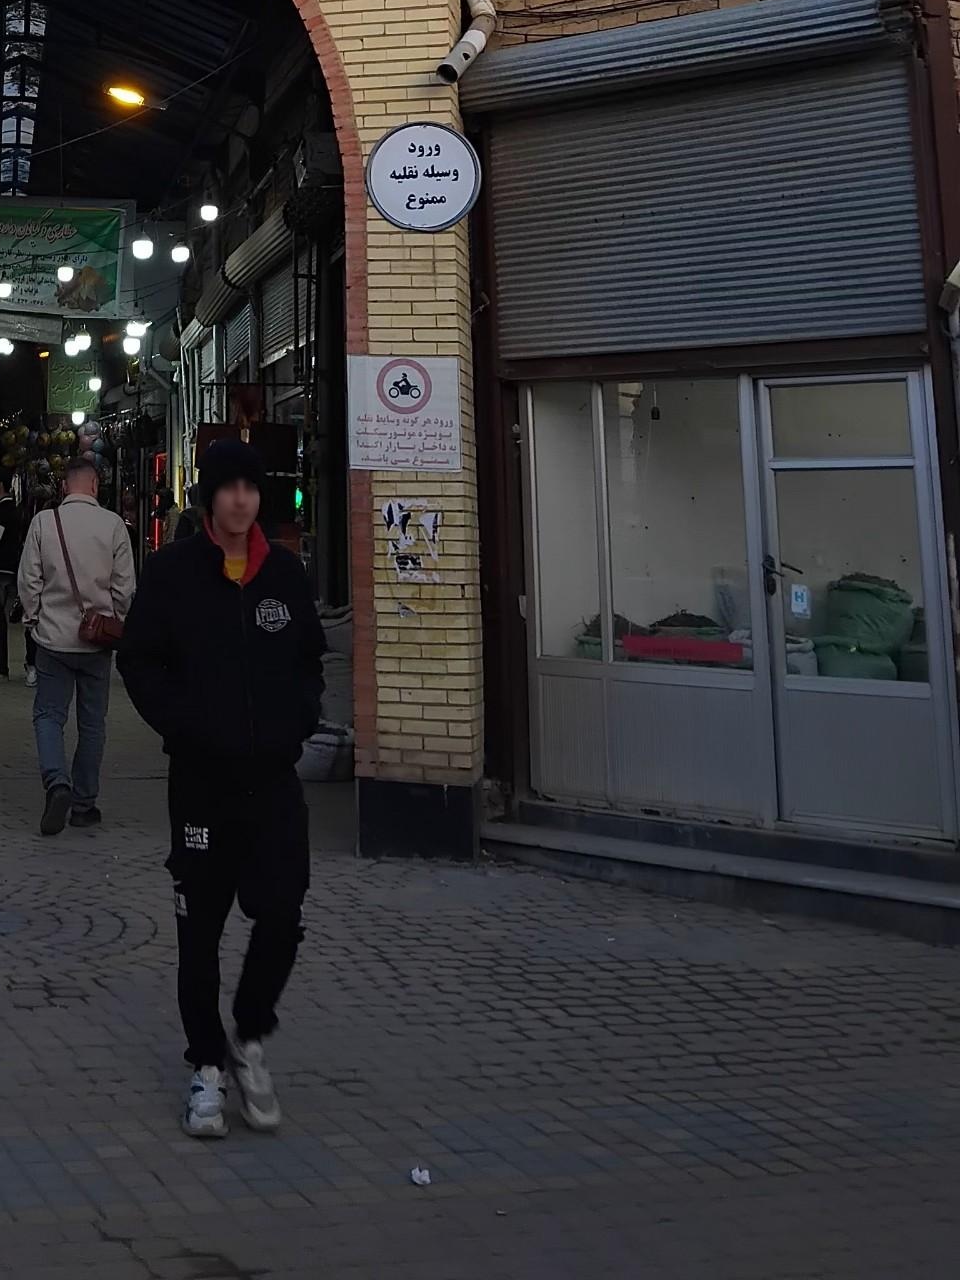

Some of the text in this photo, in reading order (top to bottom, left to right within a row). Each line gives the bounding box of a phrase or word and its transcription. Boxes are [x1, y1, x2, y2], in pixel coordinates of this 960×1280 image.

[407, 142, 441, 158] ورود
[389, 164, 459, 183] وسیله نقلیه
[405, 193, 447, 210] ممنوع
